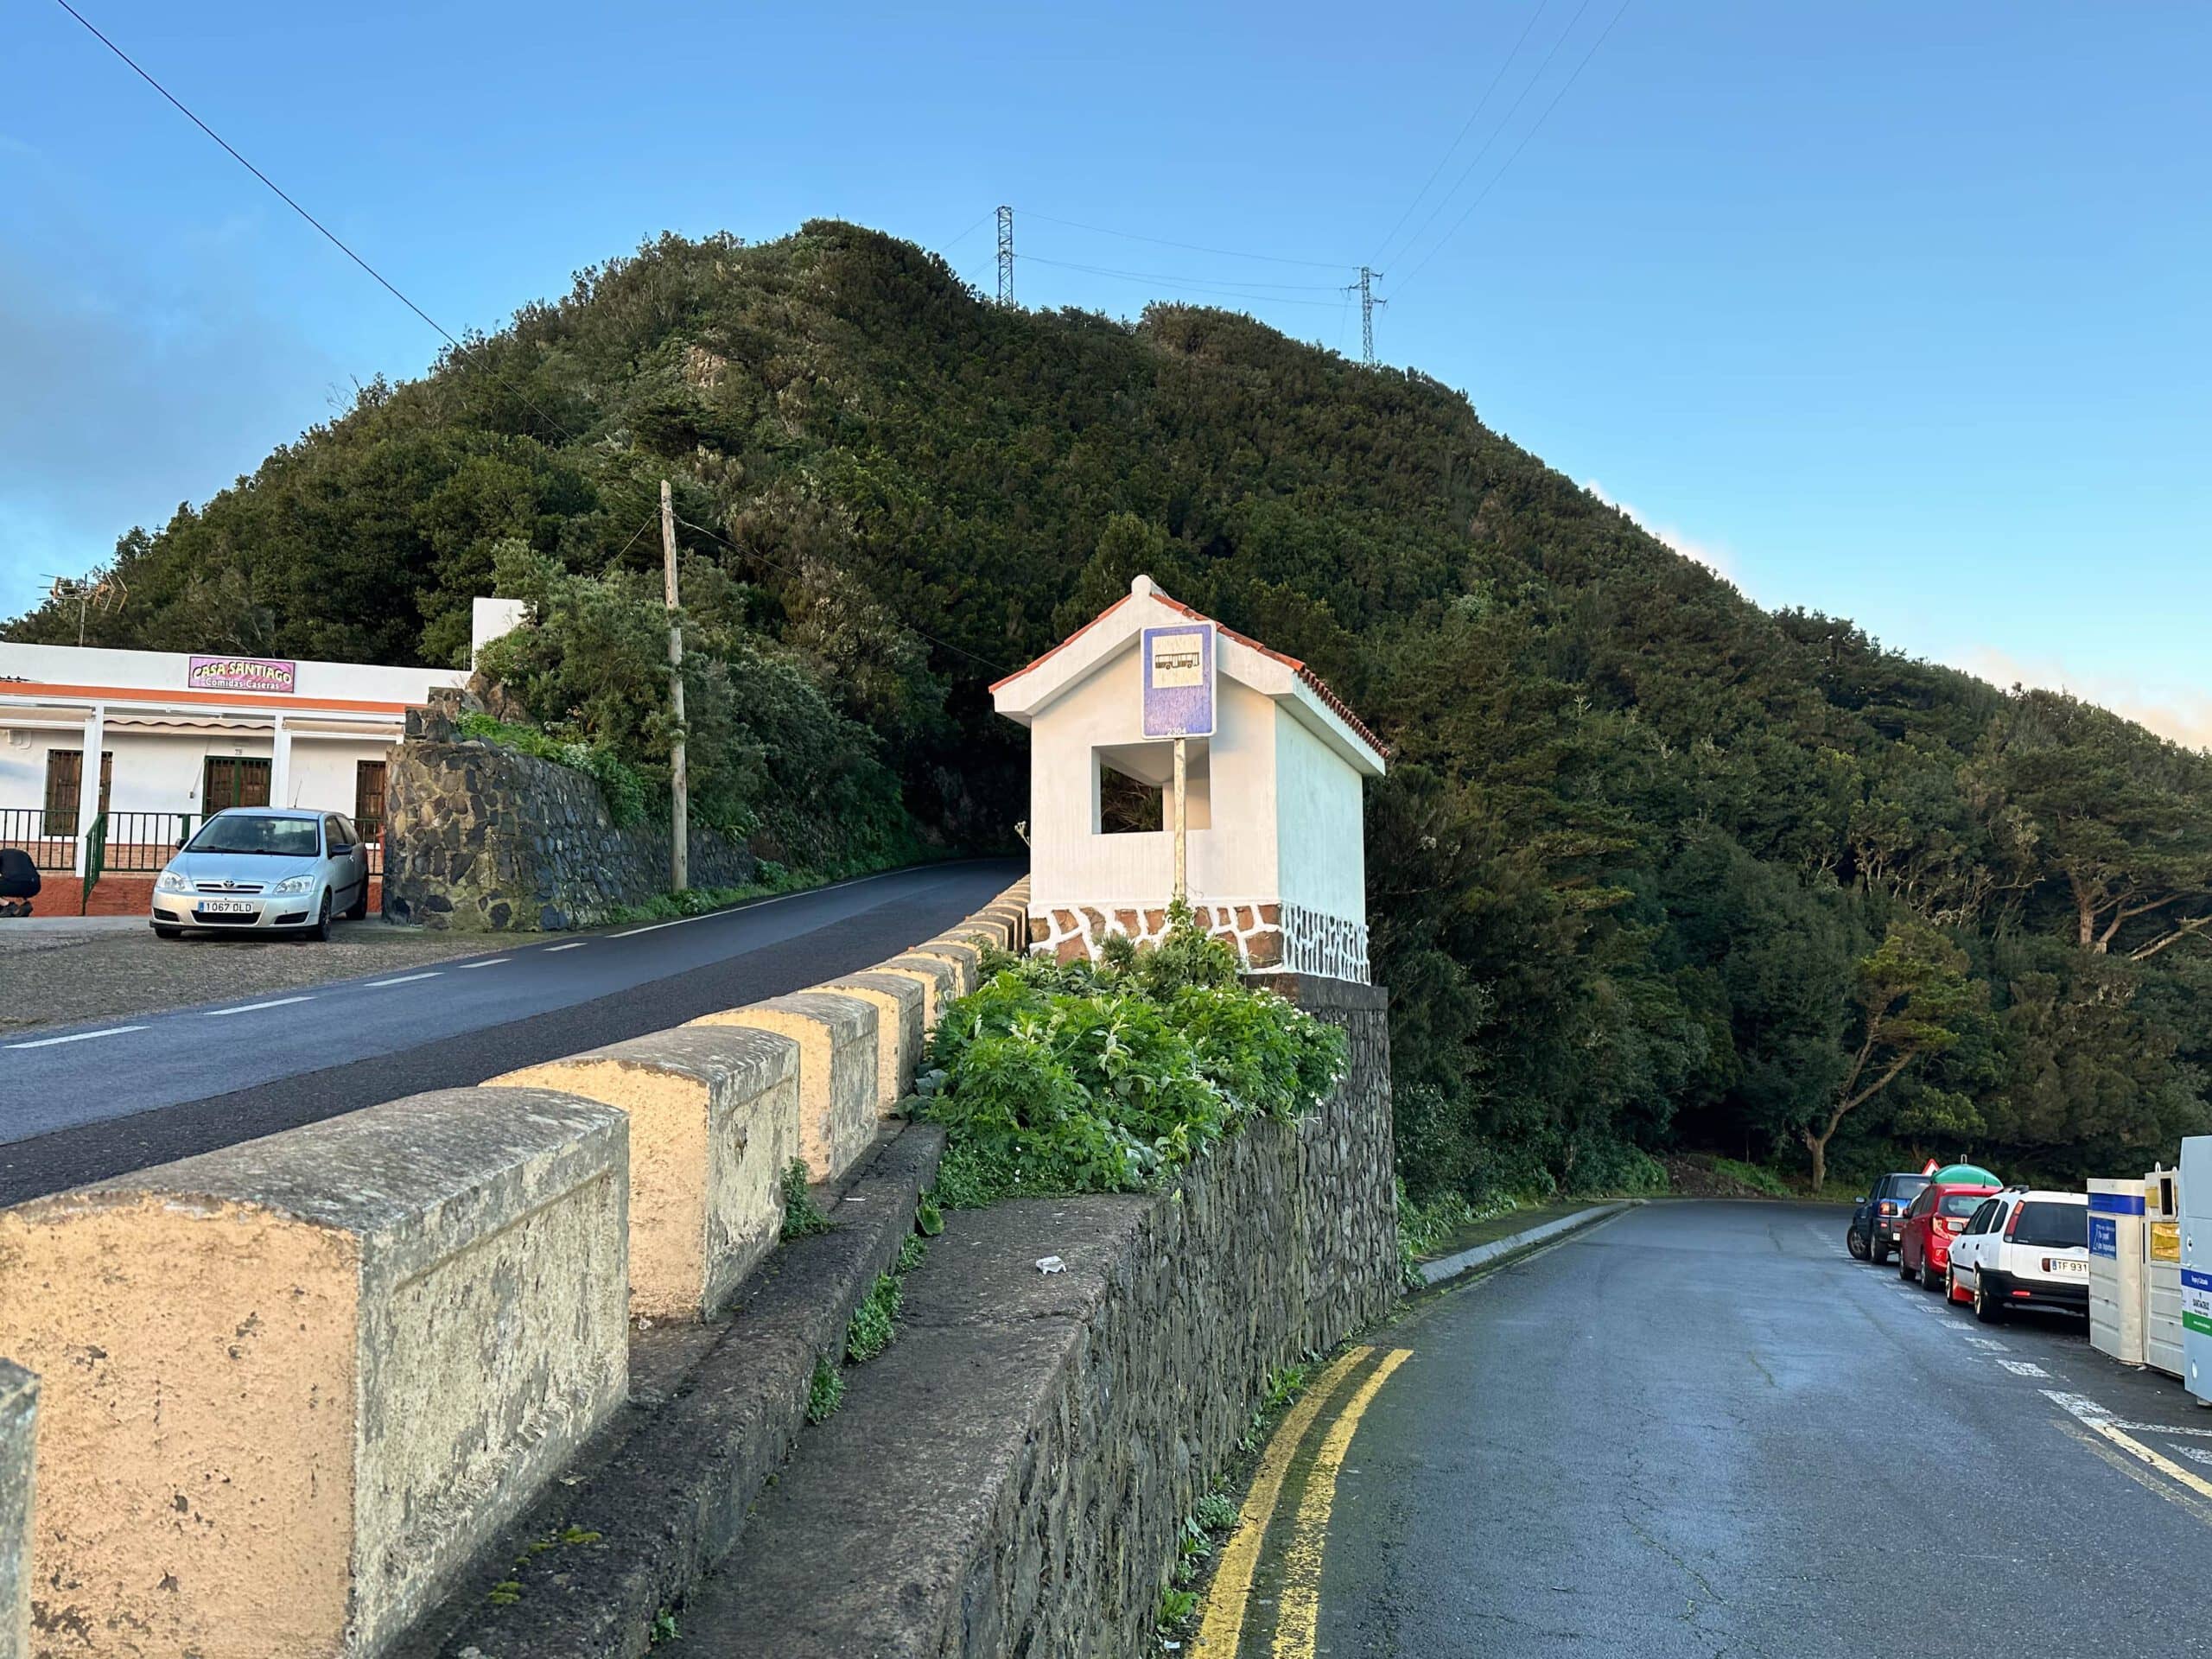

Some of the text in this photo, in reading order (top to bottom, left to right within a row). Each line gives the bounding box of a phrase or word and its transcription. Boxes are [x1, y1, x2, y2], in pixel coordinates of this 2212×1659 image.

[193, 661, 292, 684] CASA SANTIAGO
[206, 677, 280, 690] Comidas Caseras
[207, 903, 230, 912] 1067
[2057, 1261, 2069, 1270] TF
